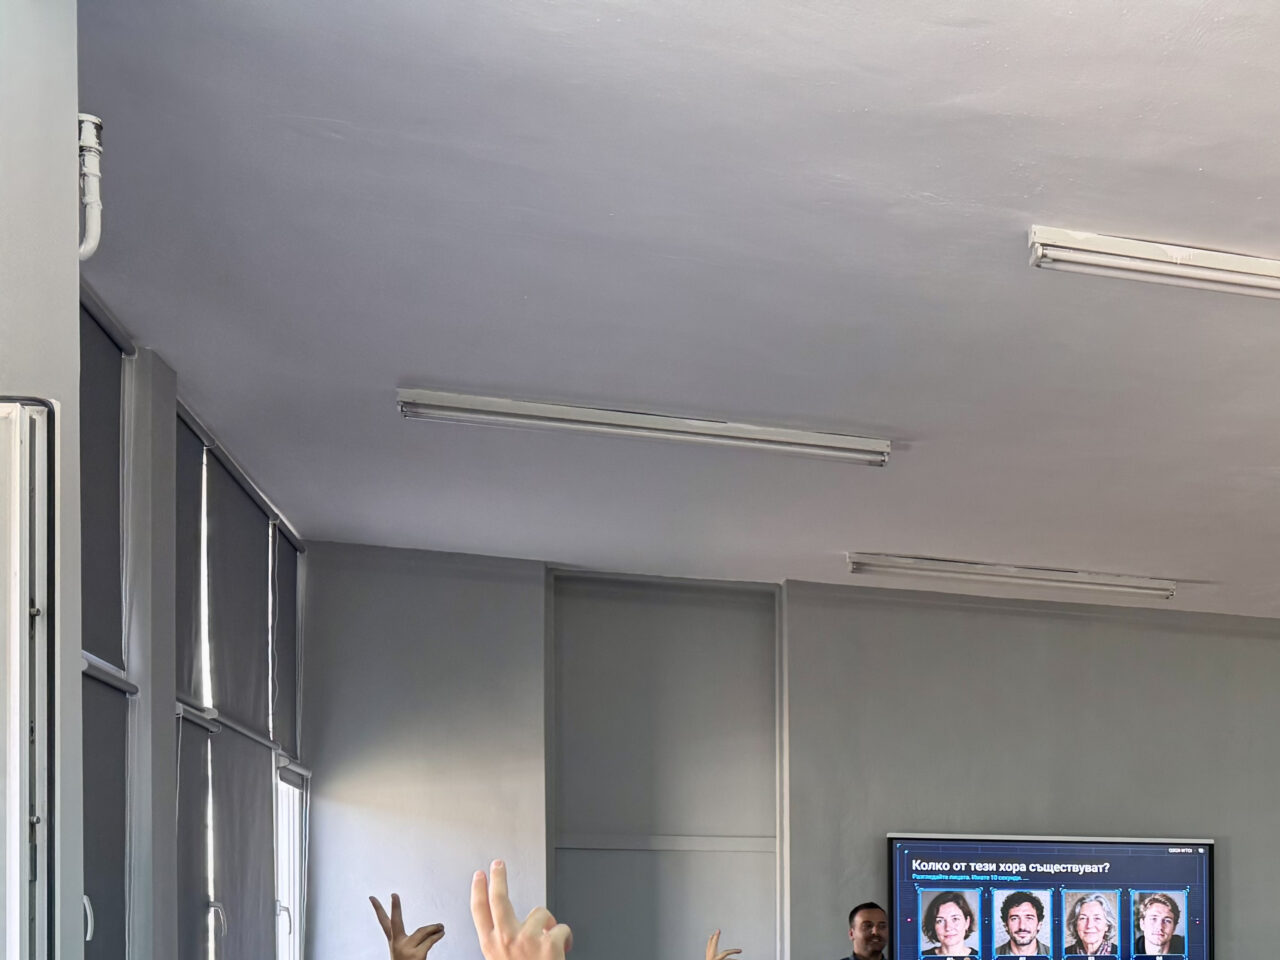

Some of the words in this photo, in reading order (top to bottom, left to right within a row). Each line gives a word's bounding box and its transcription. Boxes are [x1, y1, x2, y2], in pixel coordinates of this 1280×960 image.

[912, 860, 950, 872] Колко
[953, 863, 967, 872] от
[970, 863, 996, 872] тези
[999, 863, 1026, 875] хора
[1028, 863, 1110, 875] съществуват?
